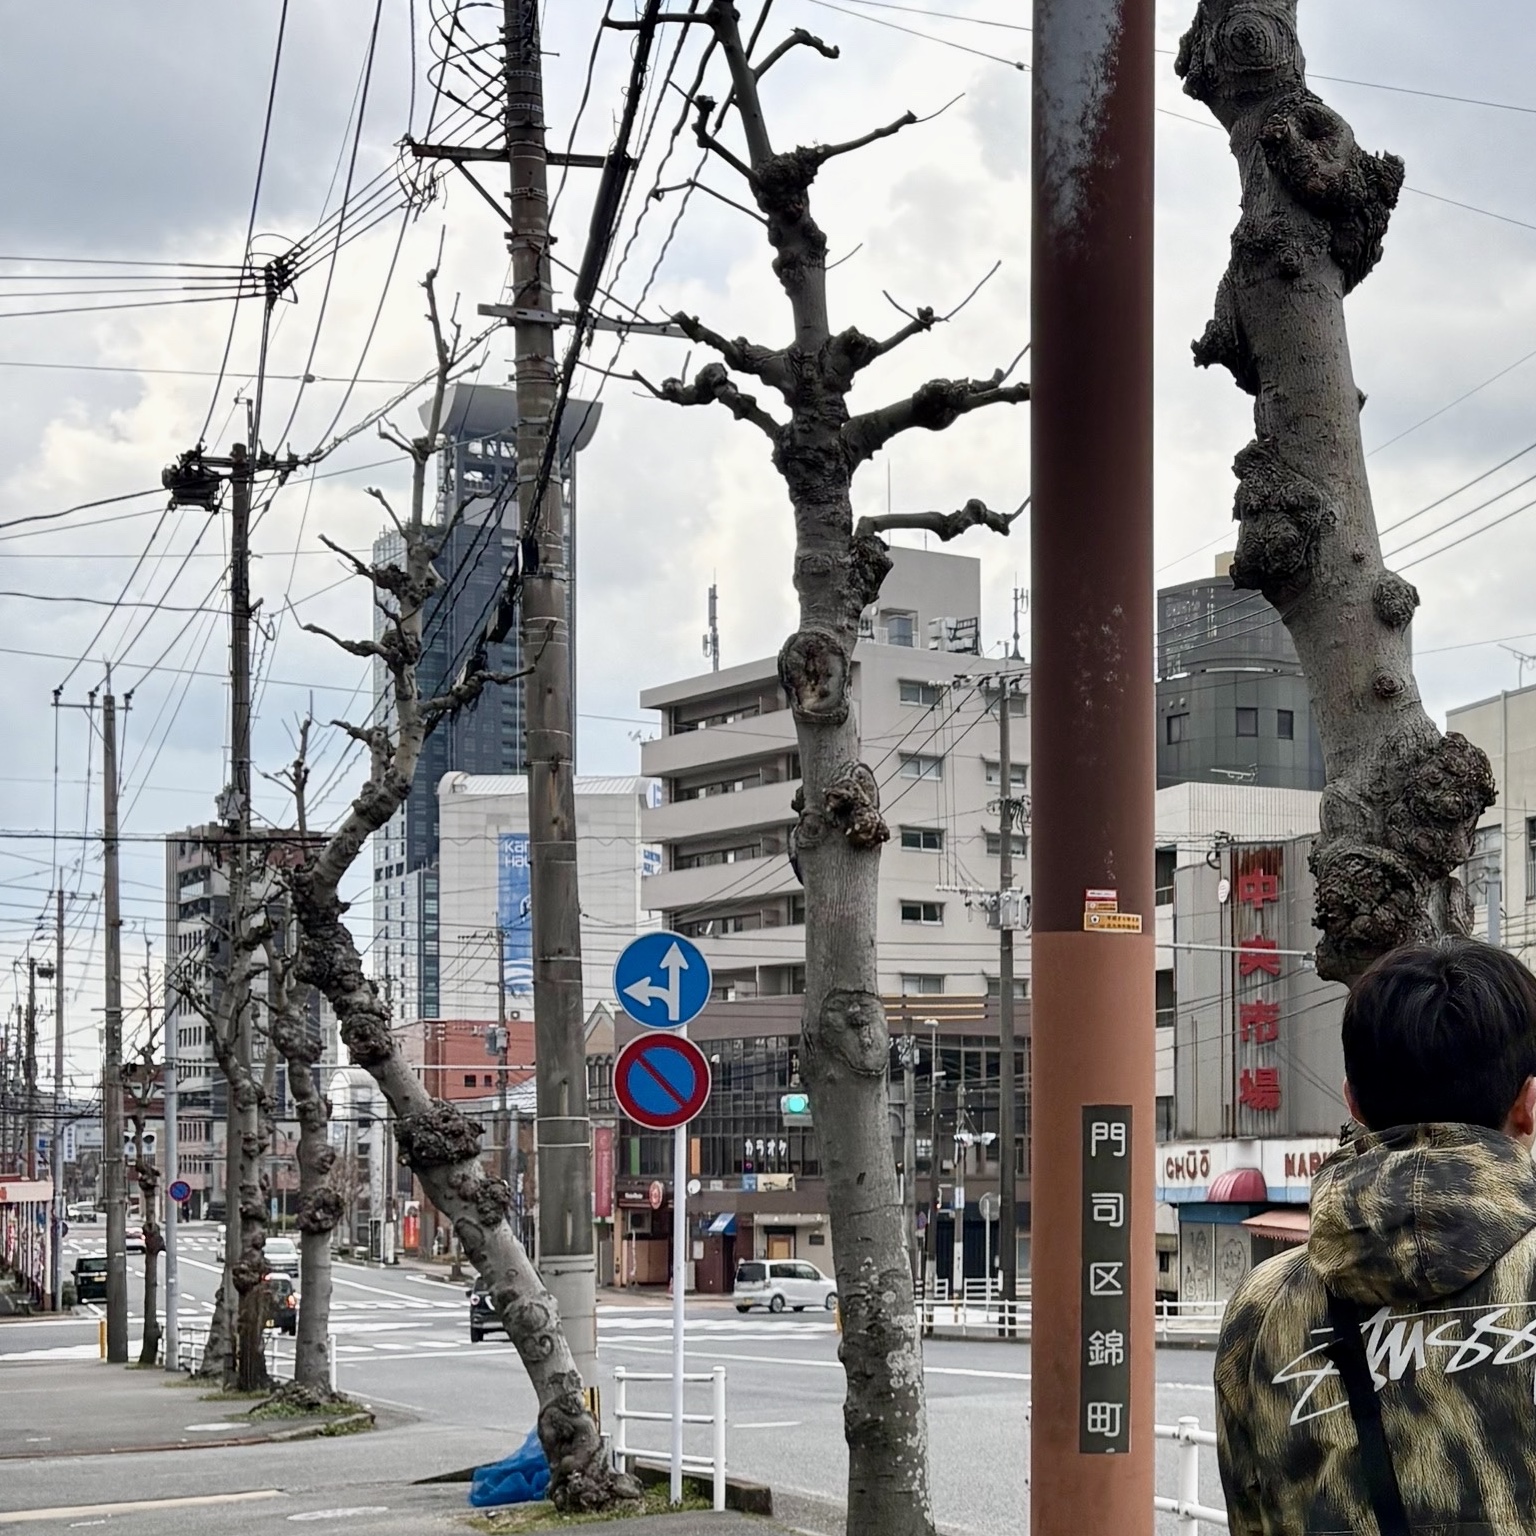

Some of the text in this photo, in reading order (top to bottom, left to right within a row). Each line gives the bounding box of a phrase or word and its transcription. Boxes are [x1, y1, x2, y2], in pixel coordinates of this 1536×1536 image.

[1238, 868, 1282, 1111] 中央市場
[745, 1138, 787, 1157] カラオケ
[1166, 1150, 1210, 1180] CHŪŌ
[1088, 1122, 1126, 1437] 門司区錦町
